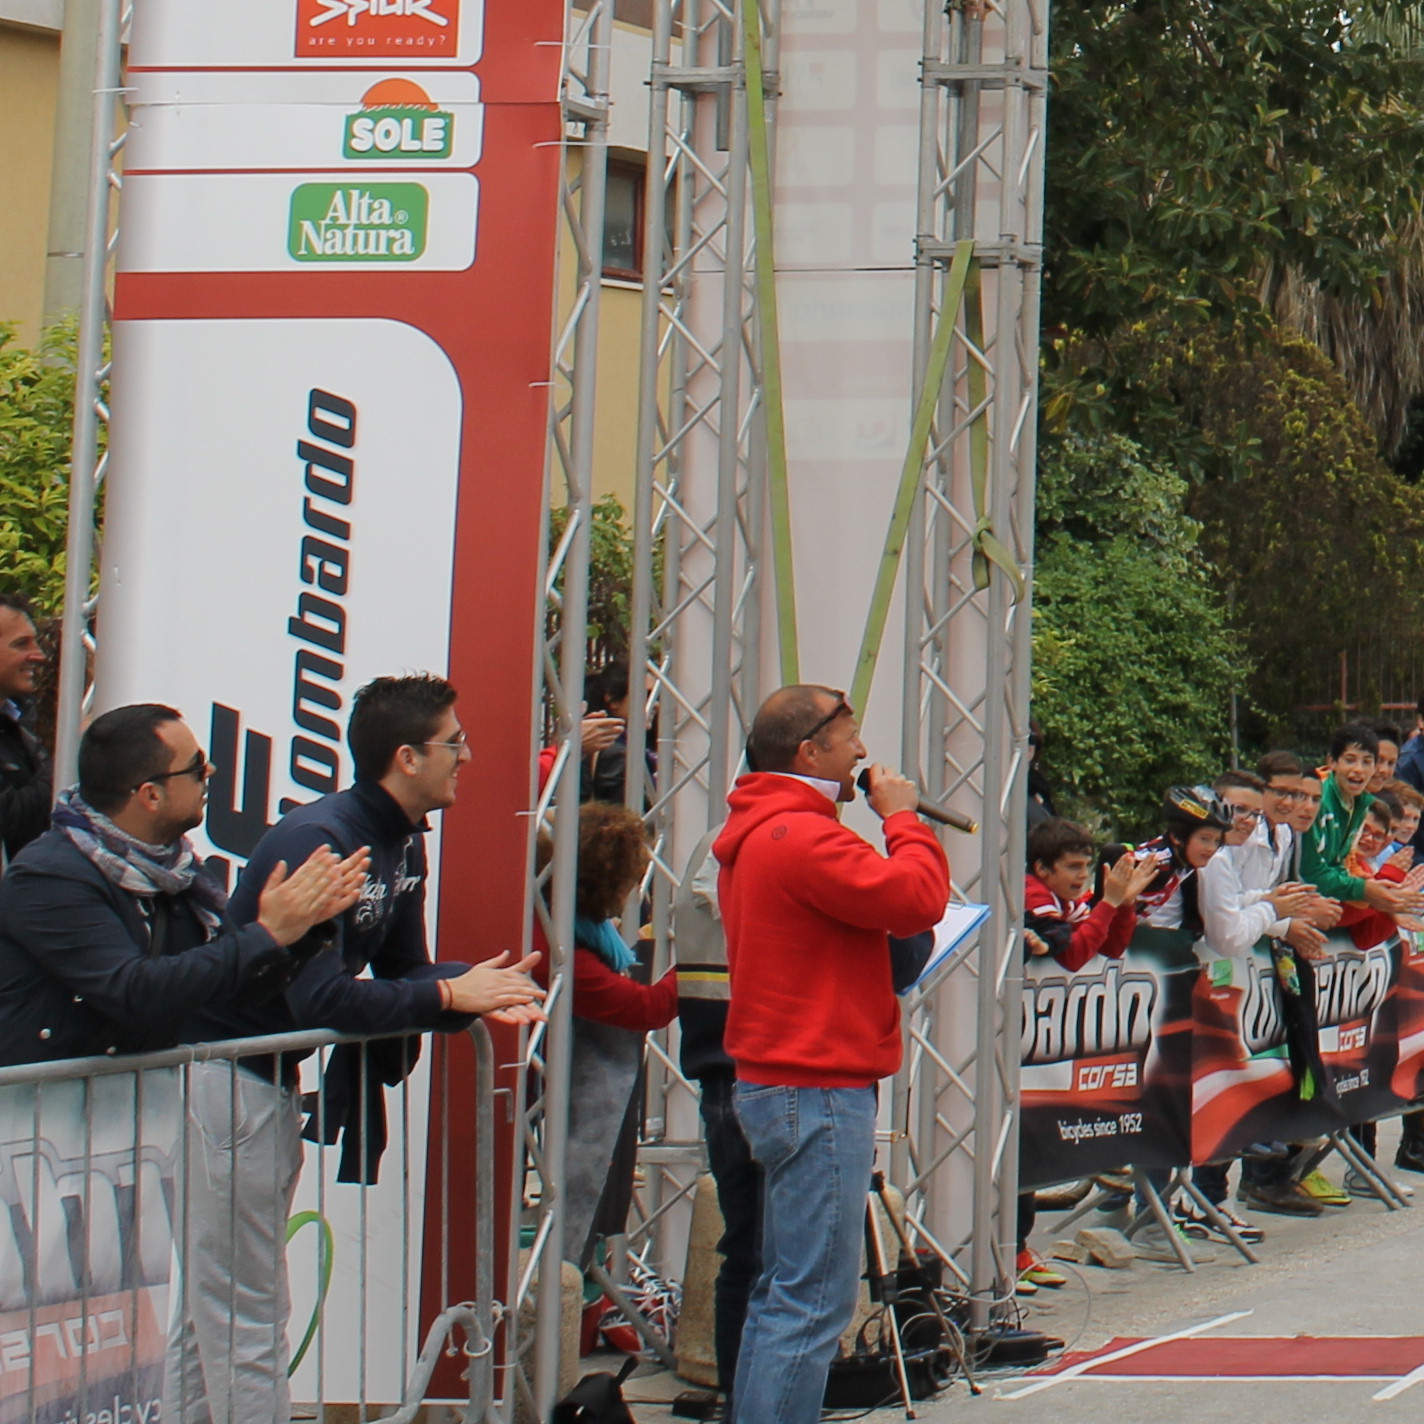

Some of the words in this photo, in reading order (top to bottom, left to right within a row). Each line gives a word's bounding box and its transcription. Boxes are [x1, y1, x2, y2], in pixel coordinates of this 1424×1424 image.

[308, 36, 336, 46] are
[346, 37, 376, 47] you
[385, 35, 447, 47] ready?
[349, 117, 447, 153] SOLE
[325, 188, 394, 225] Alta
[297, 219, 415, 256] Natura
[1077, 1062, 1138, 1092] corsa
[1057, 1118, 1095, 1144] bicycles
[1093, 1116, 1118, 1137] since
[1118, 1112, 1143, 1134] 1952
